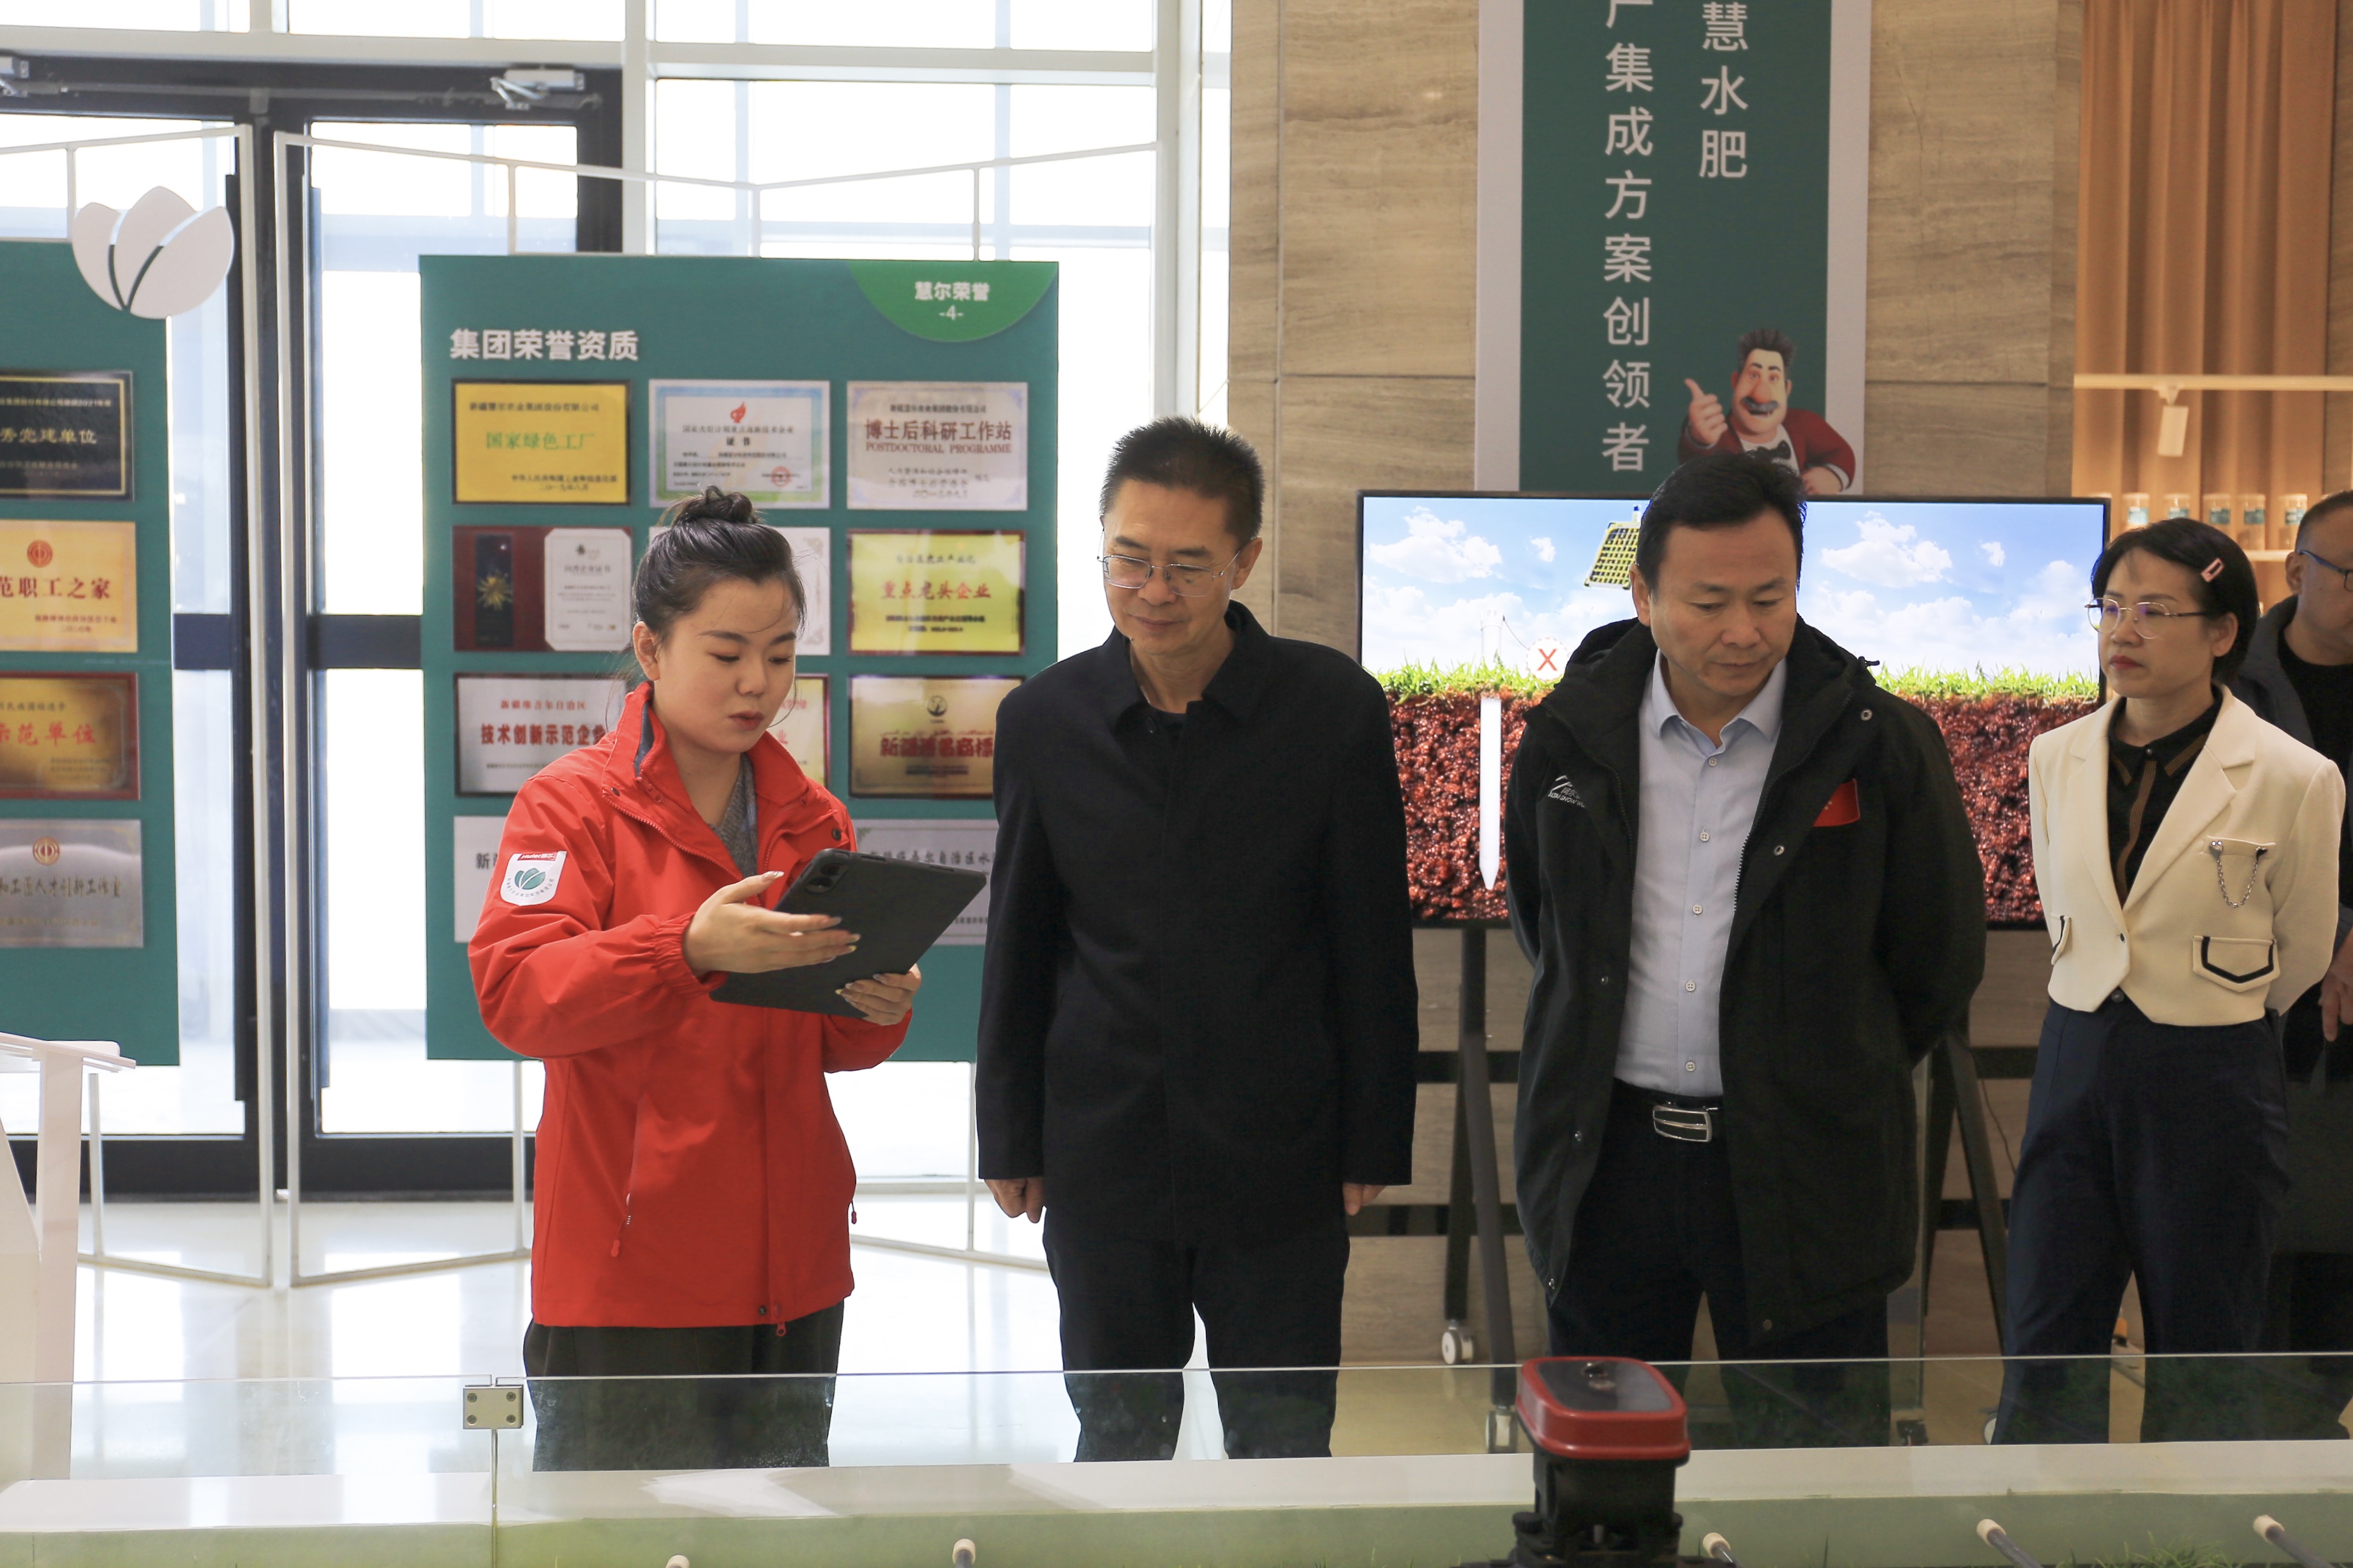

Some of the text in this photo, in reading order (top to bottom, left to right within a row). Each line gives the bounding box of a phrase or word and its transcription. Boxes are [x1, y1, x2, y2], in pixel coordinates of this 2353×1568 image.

[1699, 1, 1748, 179] 慧水肥
[915, 281, 990, 301] 慧尔荣誉
[939, 304, 964, 321] -4-
[450, 328, 638, 360] 集团荣誉资质
[865, 418, 1012, 441] 博士后科研工作站
[486, 432, 597, 450] 国家绿色工厂
[866, 442, 1012, 454] POSTDOCTORAL PROGRAMME
[882, 580, 991, 600] 重点龙头企业
[476, 853, 497, 869] 新
